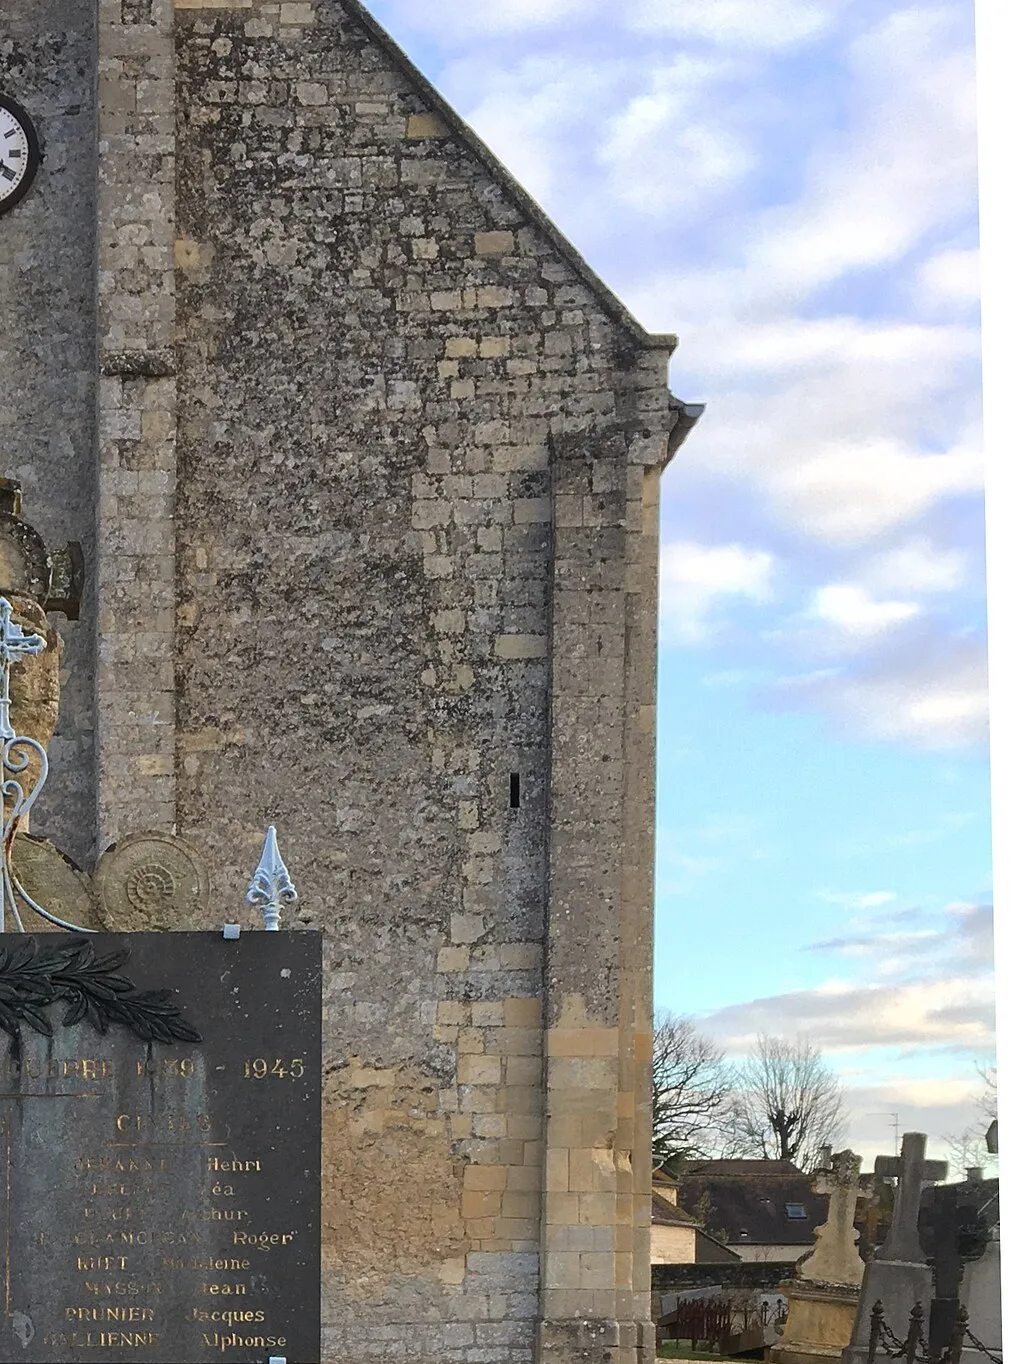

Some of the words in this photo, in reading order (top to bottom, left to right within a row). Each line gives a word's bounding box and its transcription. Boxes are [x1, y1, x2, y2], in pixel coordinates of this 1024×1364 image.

[242, 1057, 307, 1080] 1945
[207, 1157, 263, 1173] Henri
[232, 1230, 293, 1252] Roger
[63, 1306, 155, 1322] PRUNIER
[185, 1306, 266, 1328] Jacques
[200, 1331, 288, 1353] Alphonse
